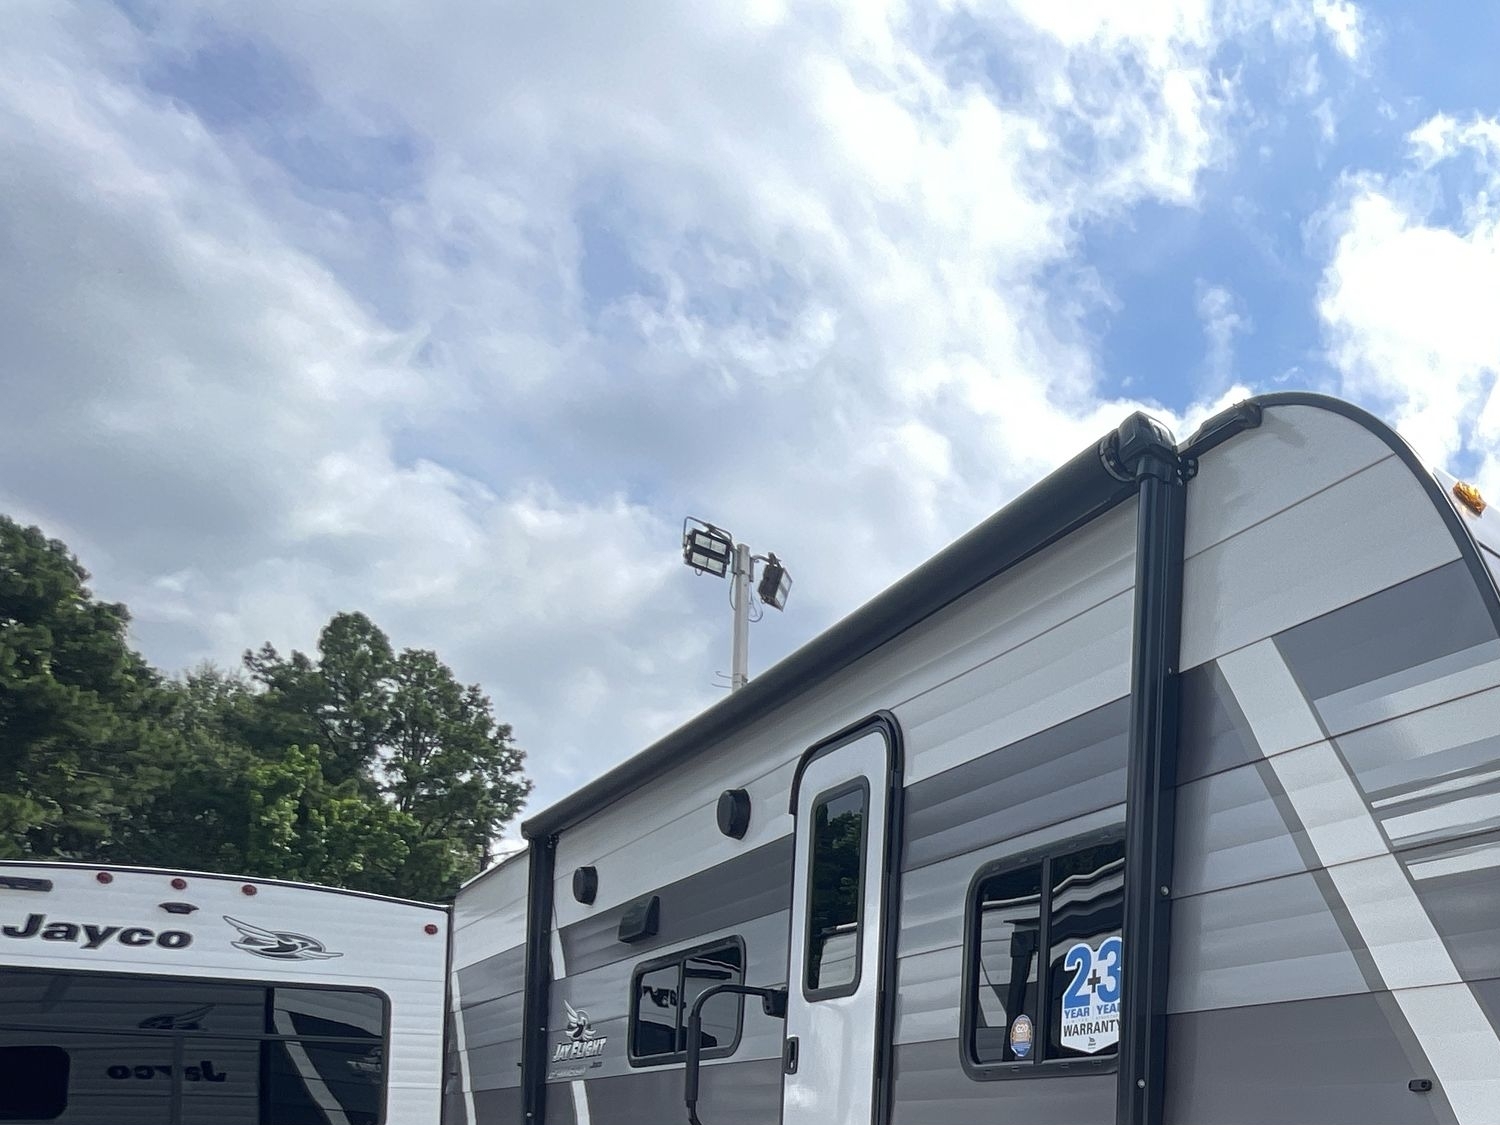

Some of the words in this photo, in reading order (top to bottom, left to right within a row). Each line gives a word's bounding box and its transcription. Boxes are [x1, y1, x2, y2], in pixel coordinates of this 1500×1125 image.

[1, 913, 193, 949] Jayco
[1064, 1007, 1090, 1019] YEAR
[1096, 1003, 1119, 1014] YEA
